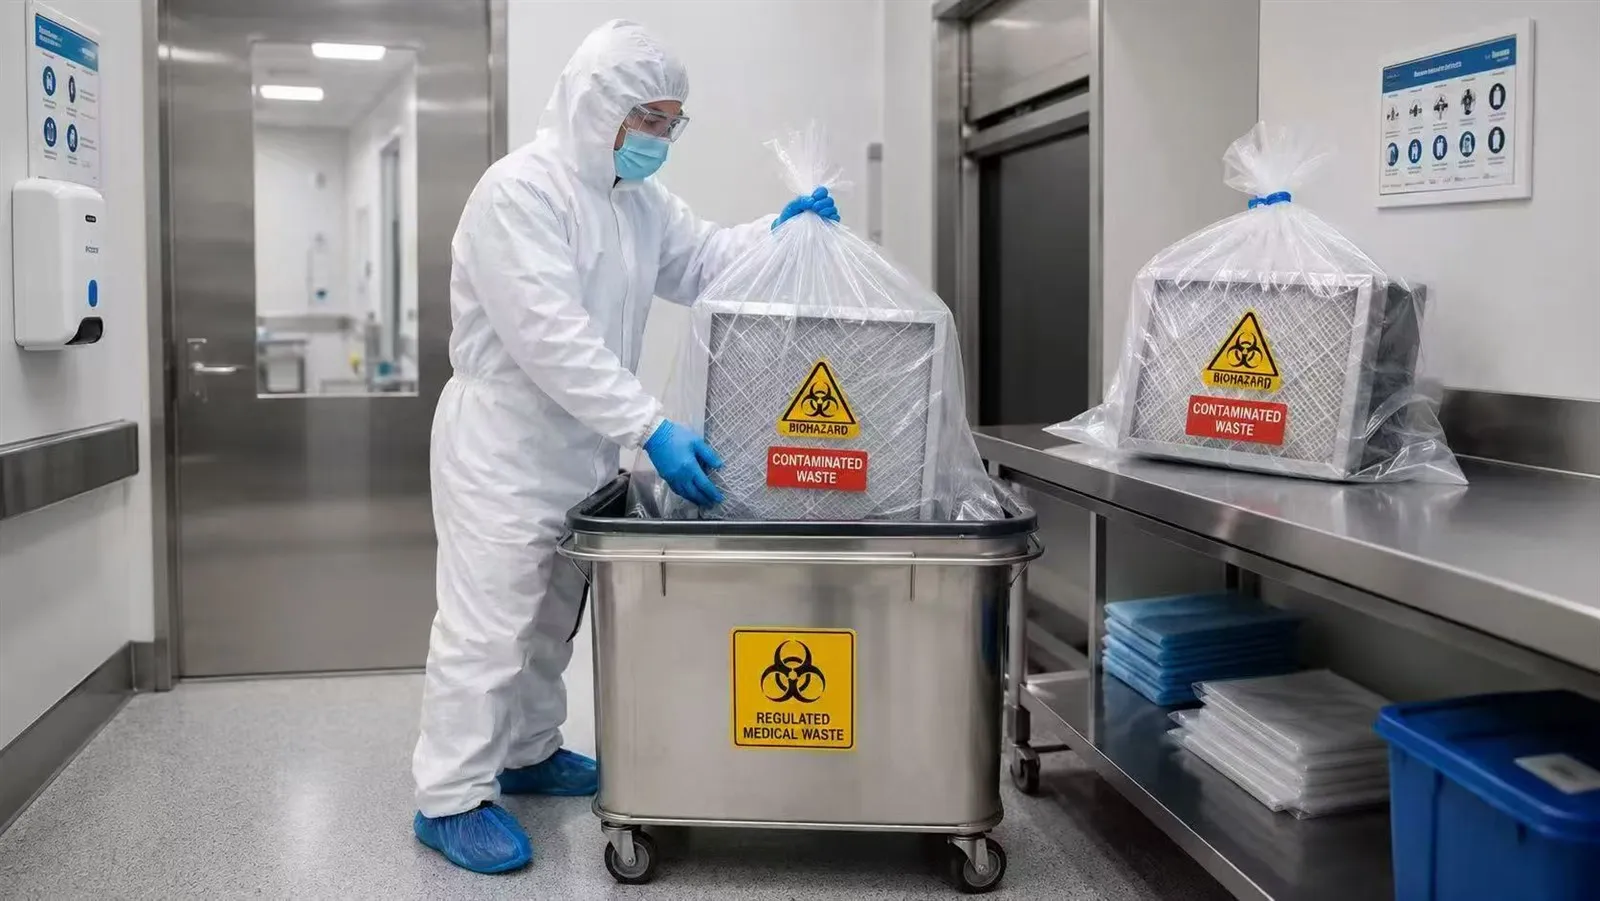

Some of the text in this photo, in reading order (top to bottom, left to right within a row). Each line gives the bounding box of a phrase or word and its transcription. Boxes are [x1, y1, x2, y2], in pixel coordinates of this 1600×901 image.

[1213, 372, 1272, 389] BIOHAZARD
[1192, 403, 1282, 423] CONTAMINATED
[789, 423, 848, 435] BIOHAZARD
[1215, 420, 1255, 436] WASTE
[772, 453, 863, 469] CONTAMINATED
[796, 470, 837, 484] WASTE
[756, 712, 830, 725] REGULATED
[743, 727, 844, 741] MEDICAL WASTE
